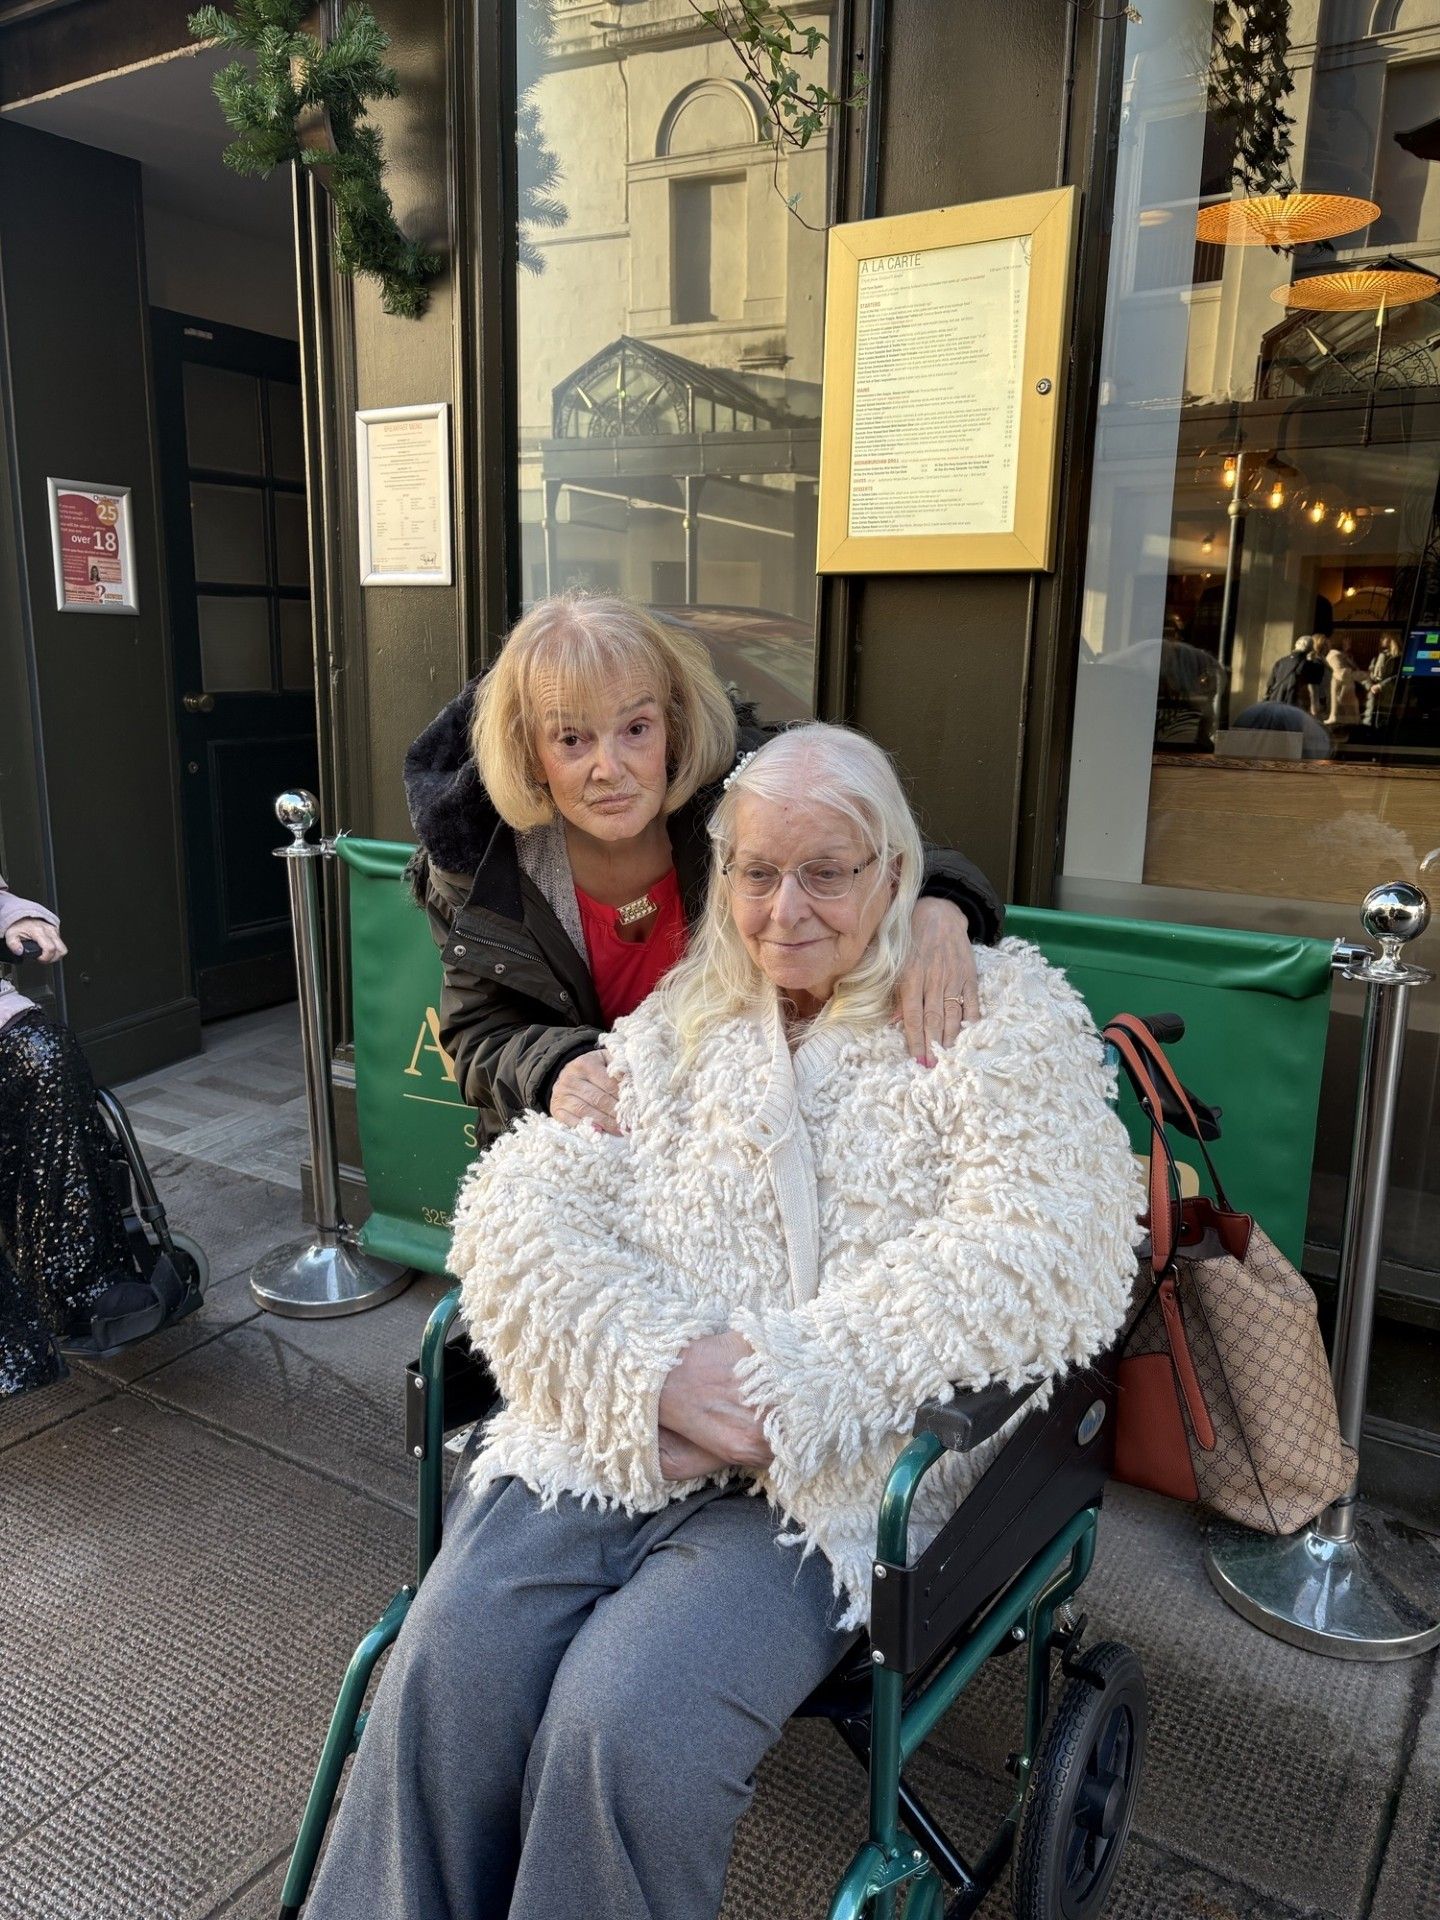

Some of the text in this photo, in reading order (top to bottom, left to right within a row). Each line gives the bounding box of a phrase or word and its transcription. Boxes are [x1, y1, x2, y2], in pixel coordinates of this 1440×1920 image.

[872, 260, 885, 272] LA
[887, 253, 921, 270] CARTE
[97, 504, 117, 521] 25
[71, 534, 91, 544] over
[93, 531, 117, 552] 18
